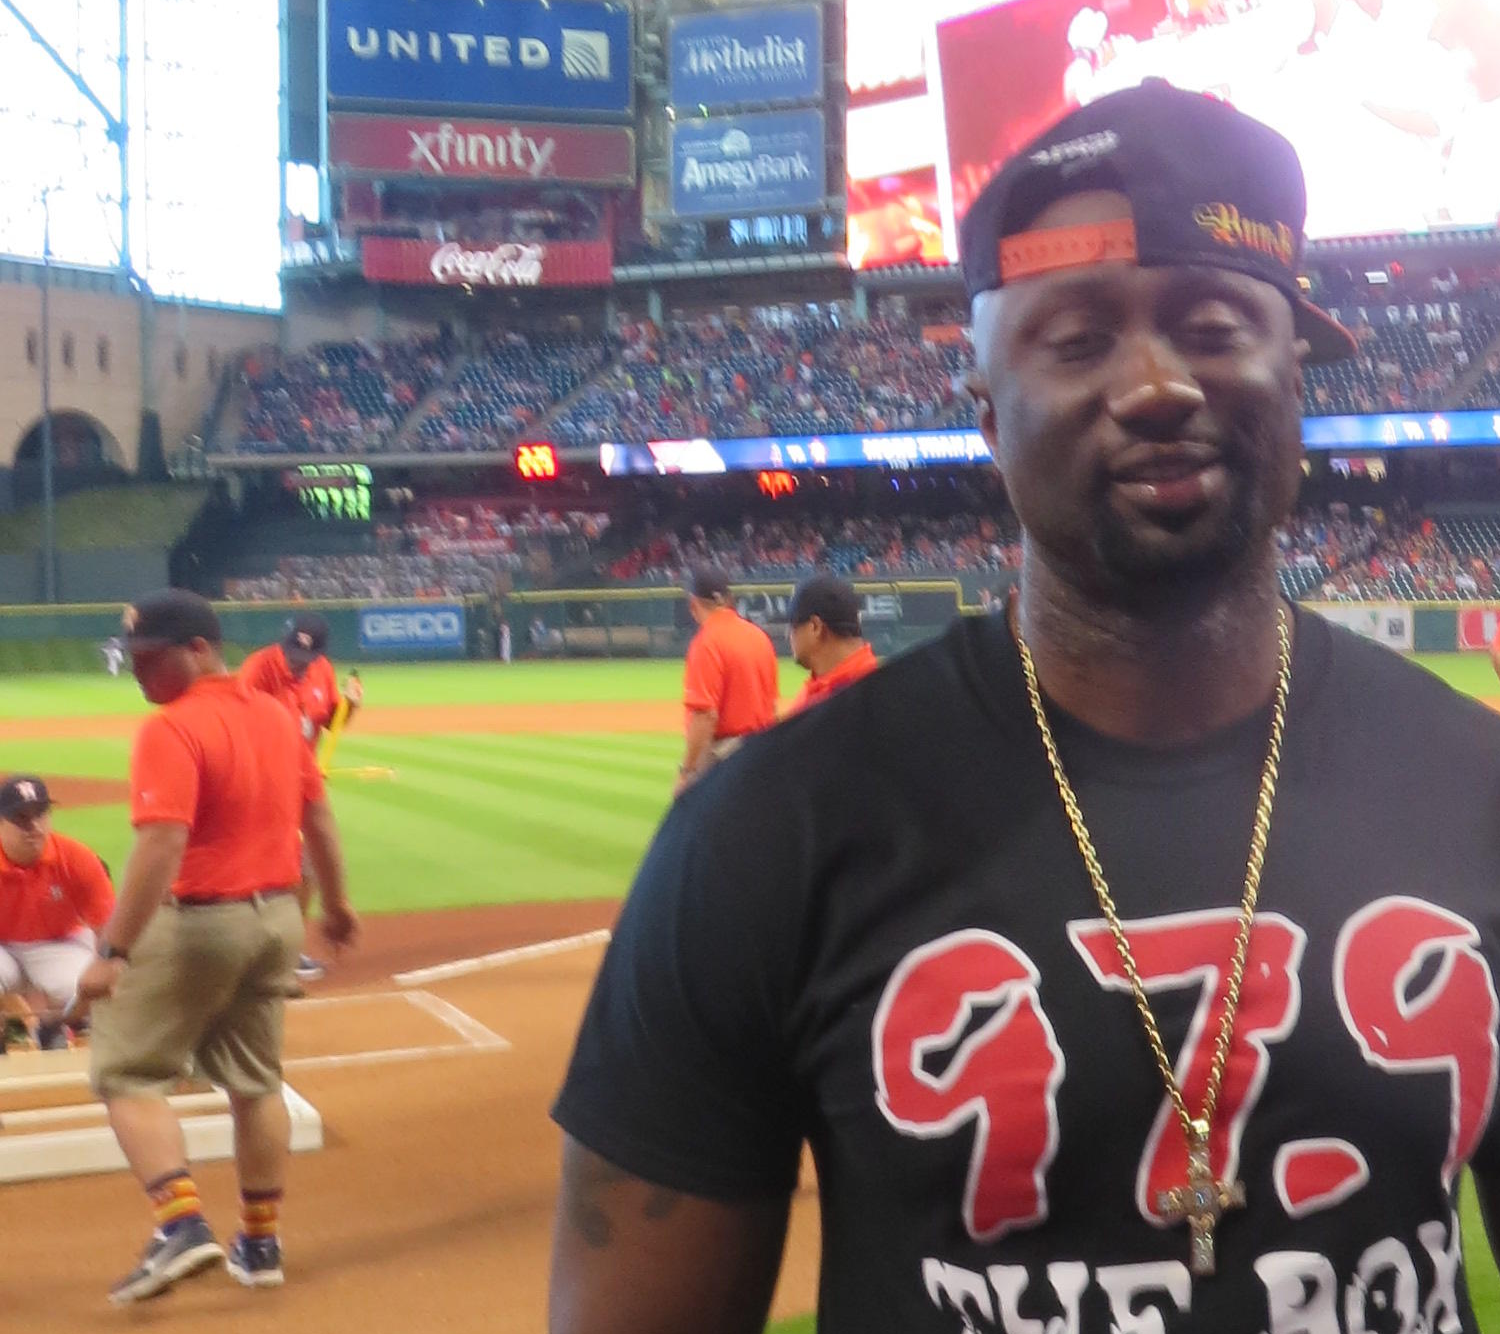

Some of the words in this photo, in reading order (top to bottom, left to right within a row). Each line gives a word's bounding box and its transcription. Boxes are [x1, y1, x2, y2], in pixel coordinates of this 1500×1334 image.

[347, 26, 550, 67] UNITED
[408, 123, 556, 176] xfinity
[363, 611, 461, 639] GEICO
